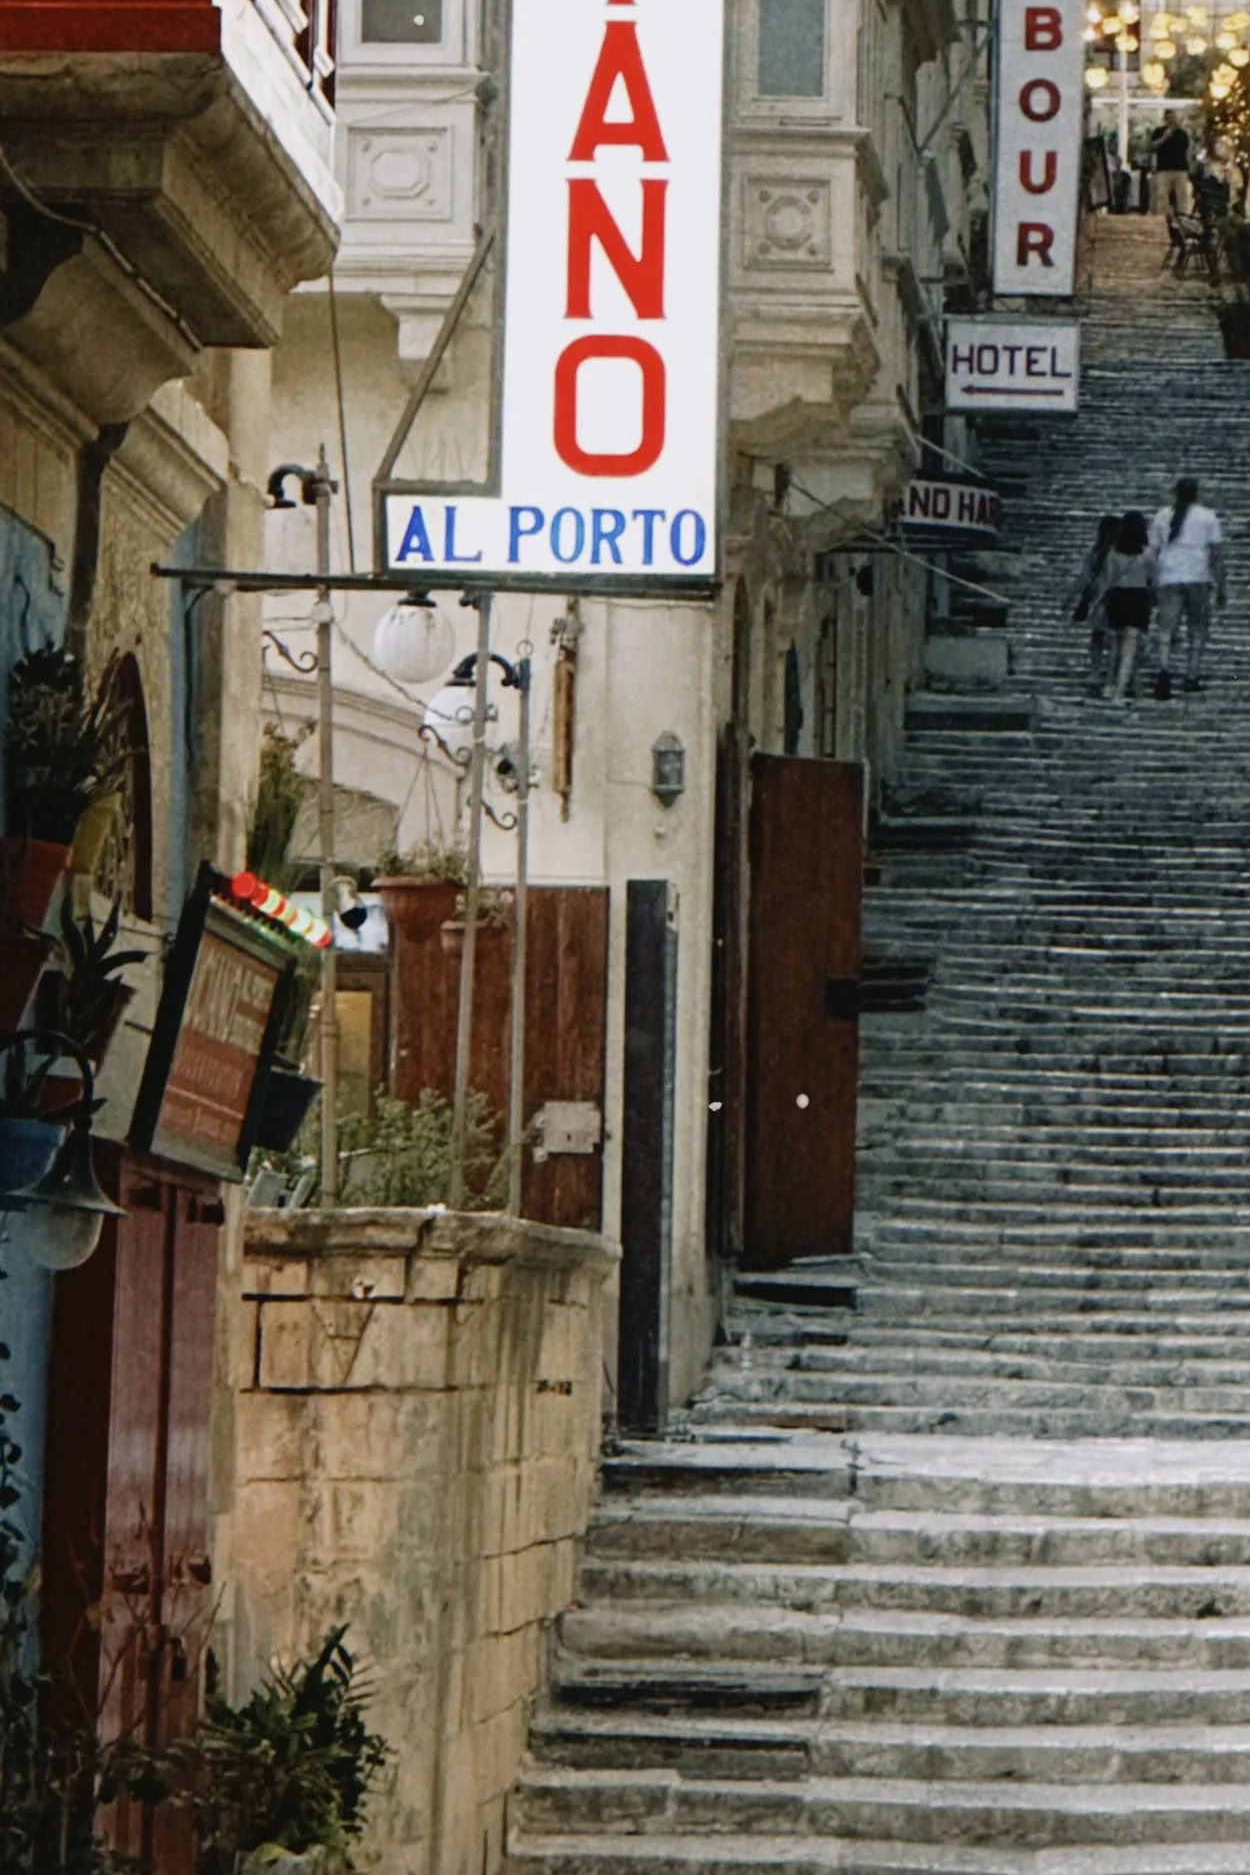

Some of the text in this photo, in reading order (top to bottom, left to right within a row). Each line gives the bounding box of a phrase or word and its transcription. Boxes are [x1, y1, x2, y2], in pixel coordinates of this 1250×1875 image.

[951, 344, 1073, 378] HOTEL
[395, 505, 707, 566] AL PORTO
